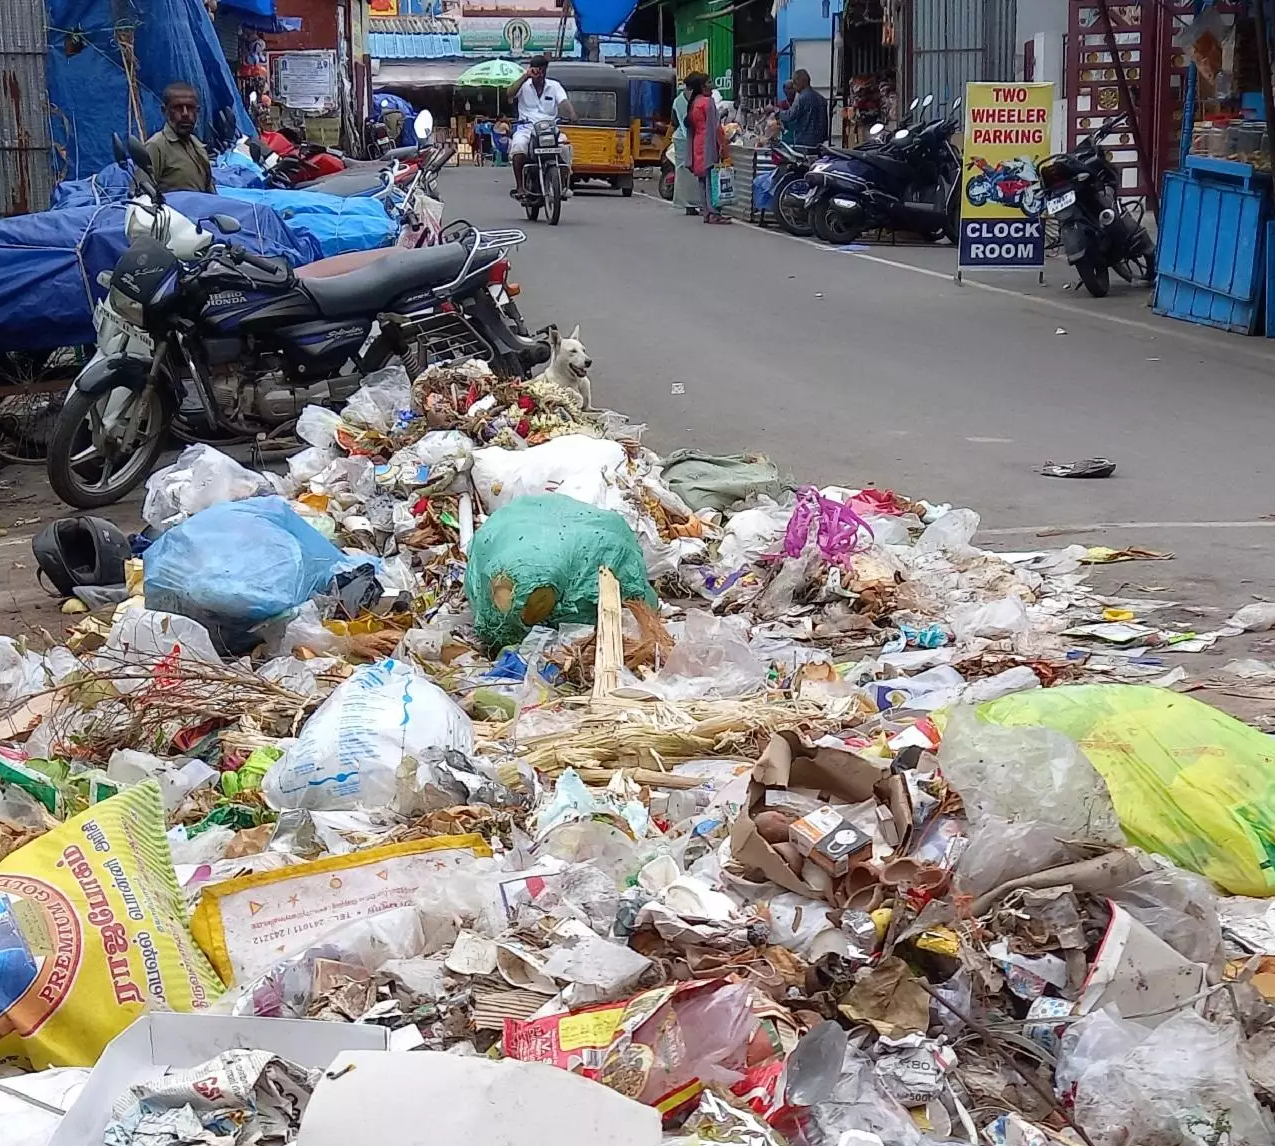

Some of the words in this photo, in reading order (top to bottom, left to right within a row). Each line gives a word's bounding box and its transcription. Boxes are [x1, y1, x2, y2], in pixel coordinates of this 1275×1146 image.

[992, 88, 1027, 102] TWO
[971, 108, 1046, 123] WHEELER
[973, 129, 1043, 144] PARKING
[966, 222, 1040, 238] CLOCK
[970, 243, 1034, 258] ROOM
[55, 844, 146, 1005] ராஜபோகம்
[39, 902, 74, 1004] PREMIUM
[131, 930, 166, 1003] பெஷல்
